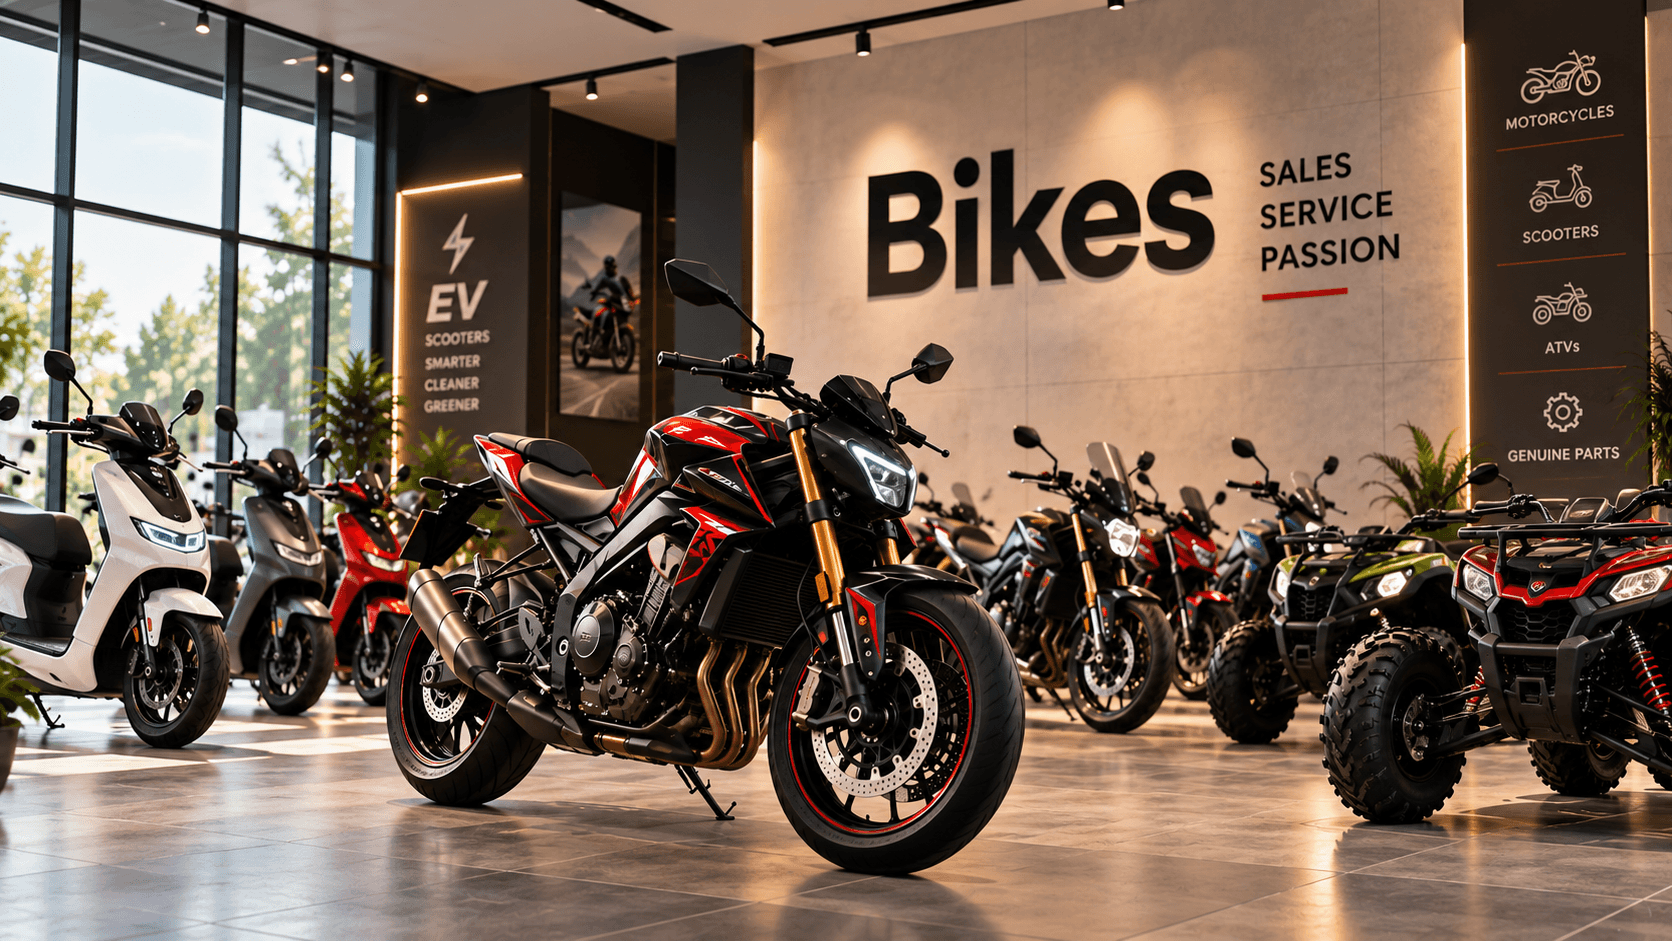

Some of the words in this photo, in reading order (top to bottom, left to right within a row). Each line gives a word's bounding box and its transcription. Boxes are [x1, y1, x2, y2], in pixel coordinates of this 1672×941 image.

[1505, 104, 1615, 130] MOTORCYCLES
[1259, 151, 1352, 187] SALES
[1260, 190, 1394, 229] SERVICE
[867, 148, 1215, 298] Bikes
[1522, 224, 1599, 244] SCOOTERS
[1261, 233, 1400, 271] PASSION
[426, 280, 489, 323] EV
[425, 330, 490, 347] SCOOTERS
[1545, 341, 1580, 355] ATVs
[425, 354, 481, 370] SMARTER
[424, 376, 480, 392] CLEANER
[424, 398, 480, 413] GREENER
[1508, 447, 1571, 462] GENUINE
[1574, 446, 1620, 461] PARTS
